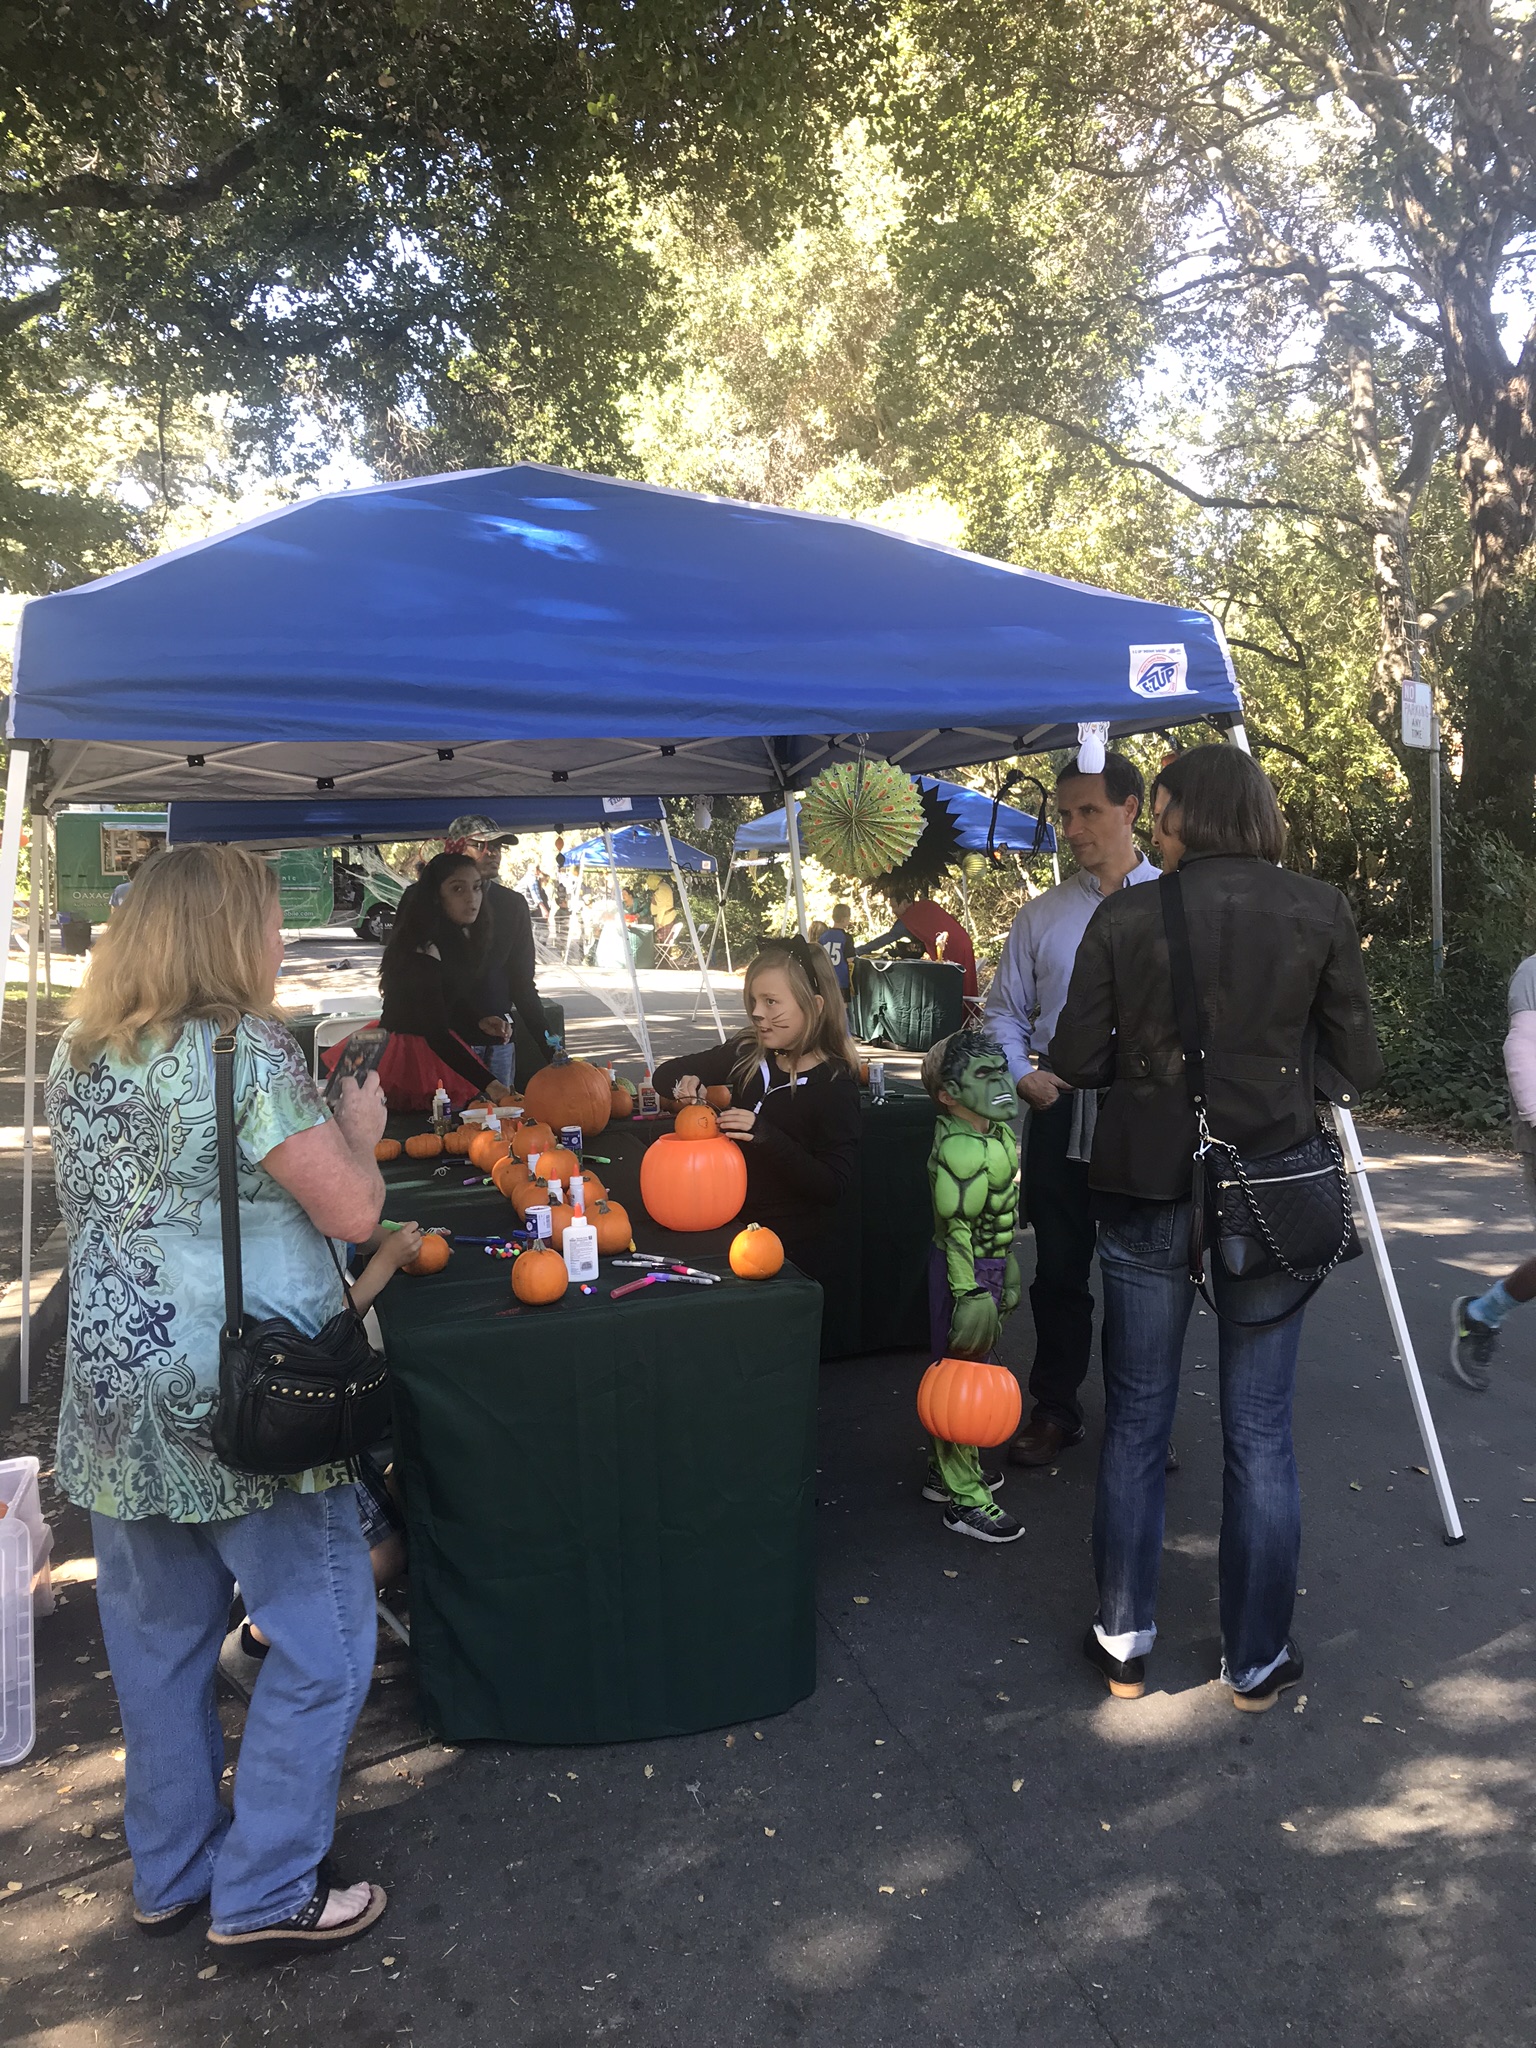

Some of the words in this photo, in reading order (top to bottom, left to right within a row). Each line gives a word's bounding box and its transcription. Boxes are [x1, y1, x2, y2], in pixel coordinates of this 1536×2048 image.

[1404, 684, 1415, 701] NO
[1404, 703, 1429, 718] PARKING
[1411, 718, 1423, 728] ANY
[1411, 728, 1423, 740] TIME
[823, 941, 842, 966] 15
